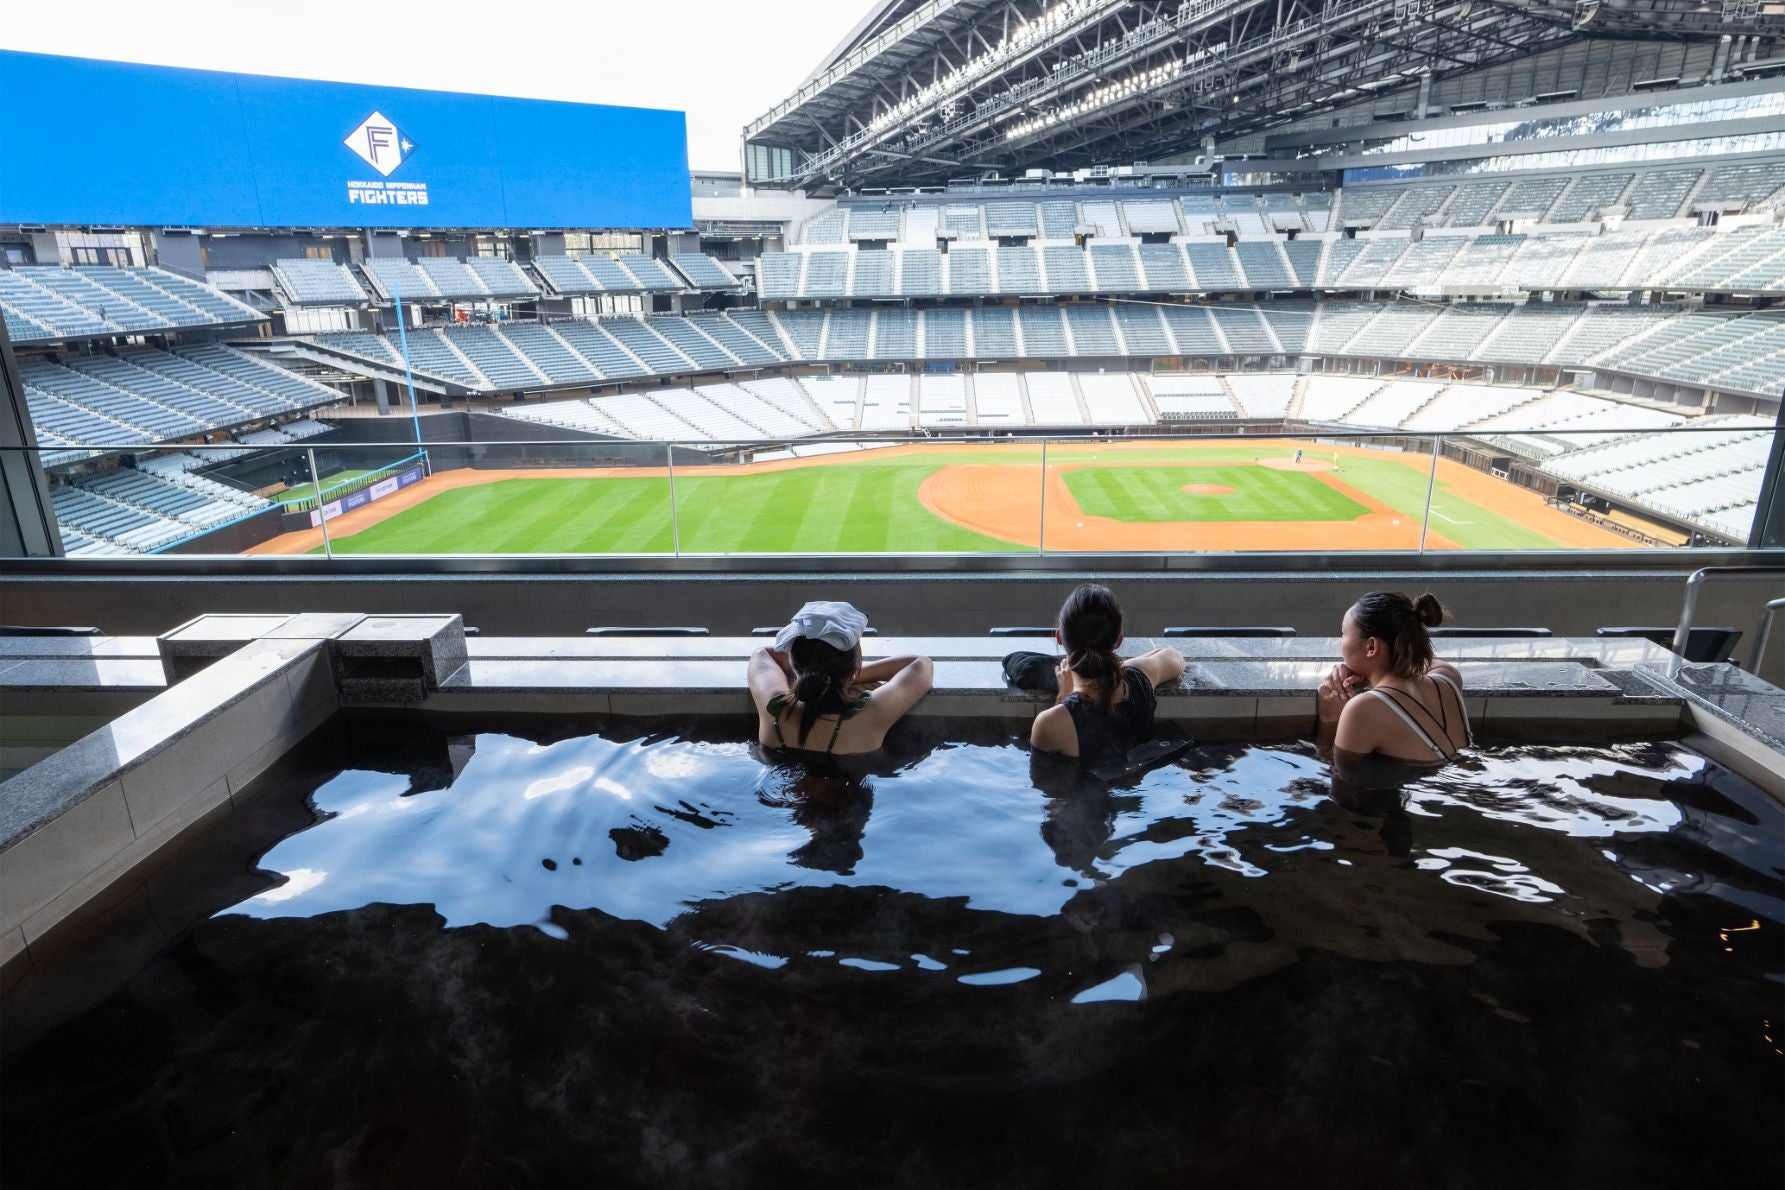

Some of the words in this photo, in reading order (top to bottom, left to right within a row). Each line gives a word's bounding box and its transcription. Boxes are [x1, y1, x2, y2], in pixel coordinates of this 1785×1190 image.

[366, 126, 393, 164] F
[347, 181, 384, 189] HOKKAIDO
[348, 189, 429, 205] FIGHTERS
